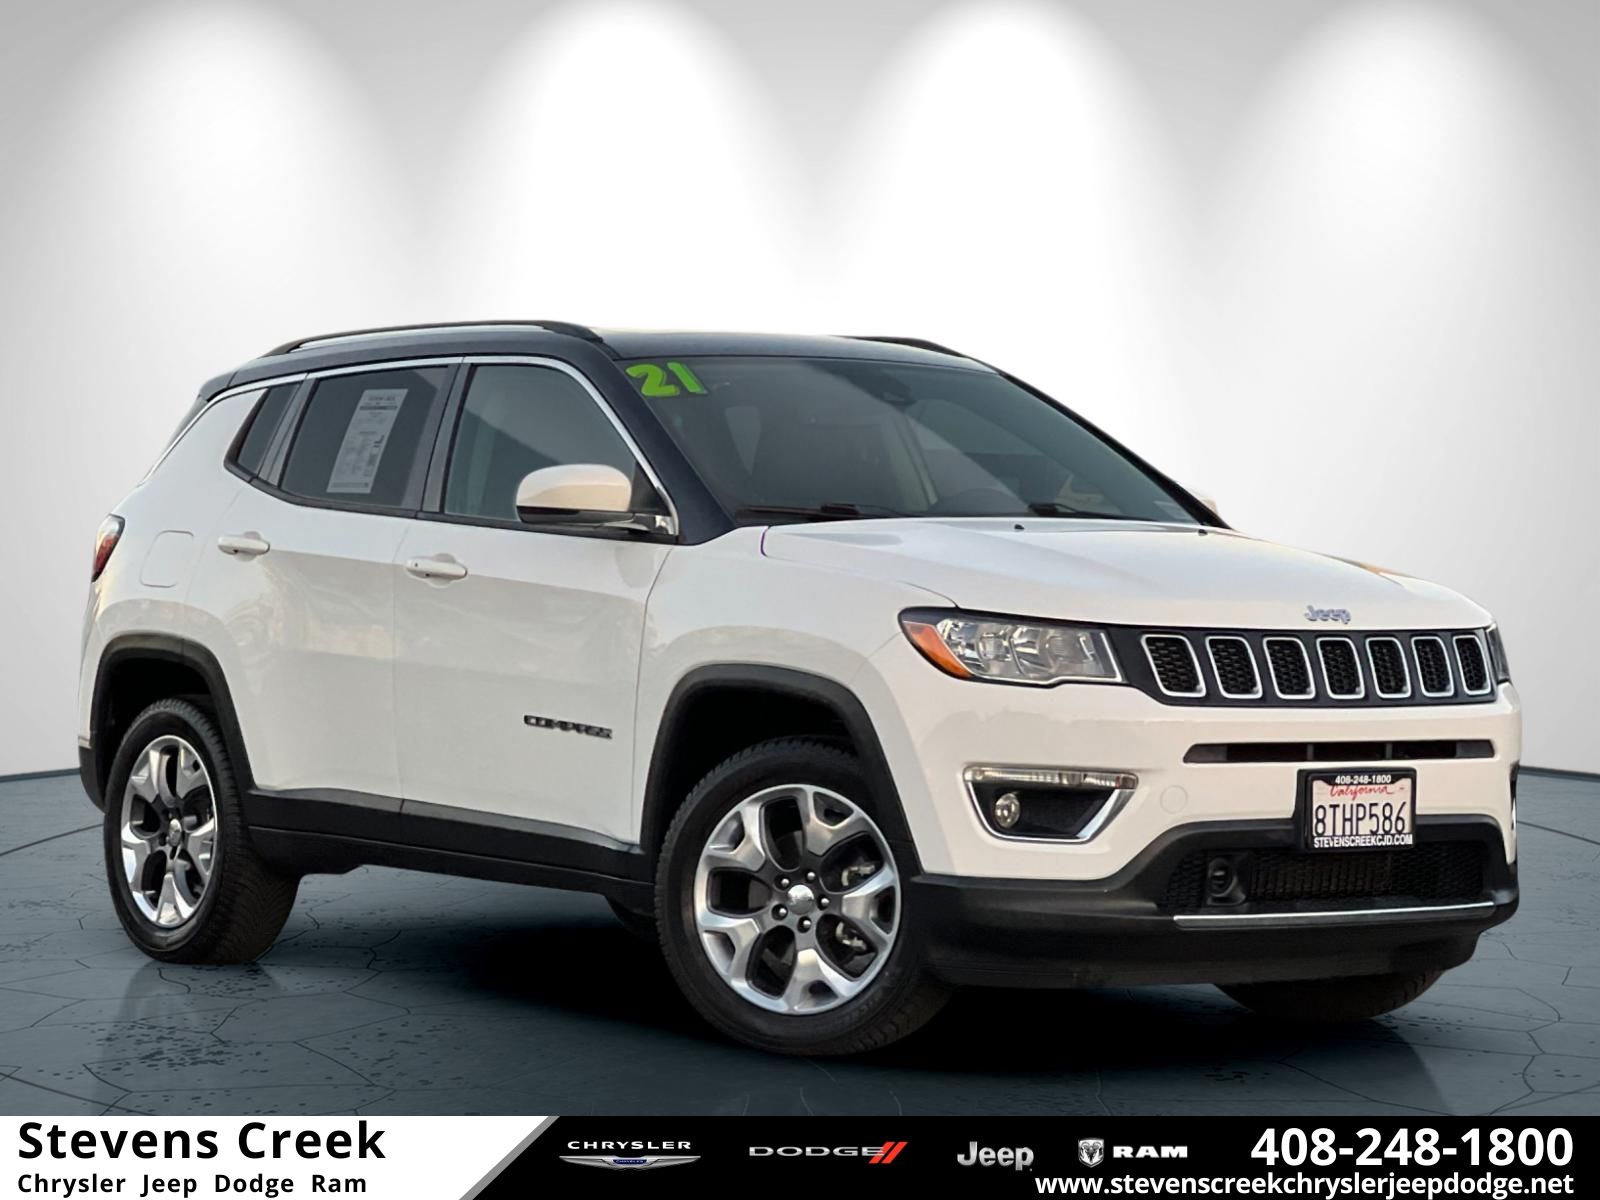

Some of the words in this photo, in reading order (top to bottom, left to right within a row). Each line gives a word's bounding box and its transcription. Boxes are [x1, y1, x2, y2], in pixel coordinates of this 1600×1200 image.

[625, 361, 709, 397] 21
[1303, 605, 1351, 625] Jeep
[1334, 774, 1392, 785] 408-248-1800
[1329, 784, 1394, 800] California
[1314, 801, 1407, 837] 8THP586
[1313, 833, 1413, 849] STEVENSCREEKCJD.COM
